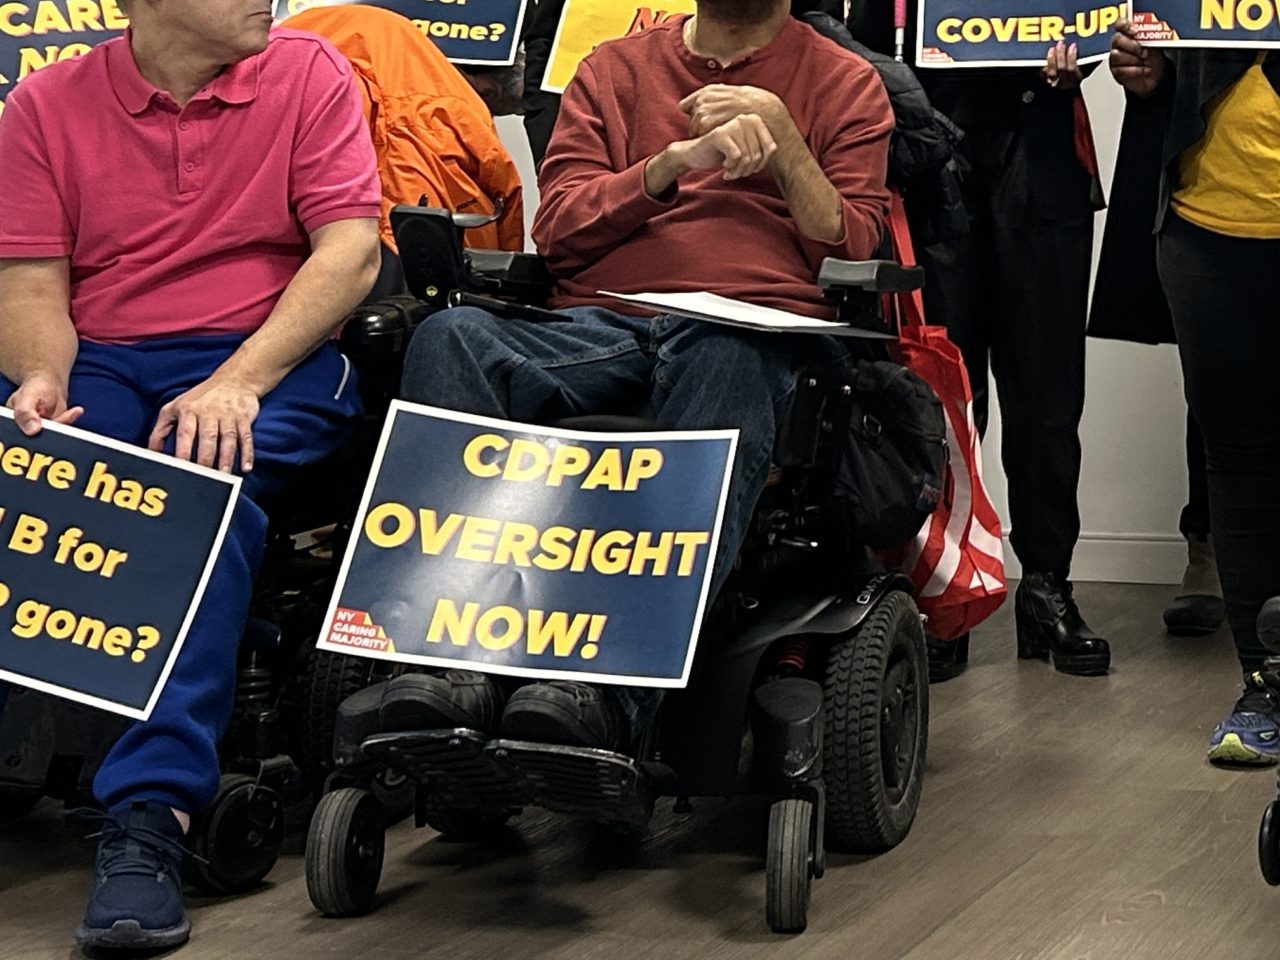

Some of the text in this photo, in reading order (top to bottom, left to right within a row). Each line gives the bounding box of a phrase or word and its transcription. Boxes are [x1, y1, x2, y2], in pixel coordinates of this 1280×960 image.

[84, 461, 169, 517] has
[463, 434, 665, 492] CDPAP
[8, 513, 49, 555] B
[54, 527, 128, 579] for
[365, 502, 710, 577] OVERSIGHT
[11, 599, 160, 663] gone?
[329, 632, 389, 649] MAJORITY
[333, 622, 377, 638] CARING
[336, 611, 356, 623] NY
[426, 598, 607, 660] NOW!
